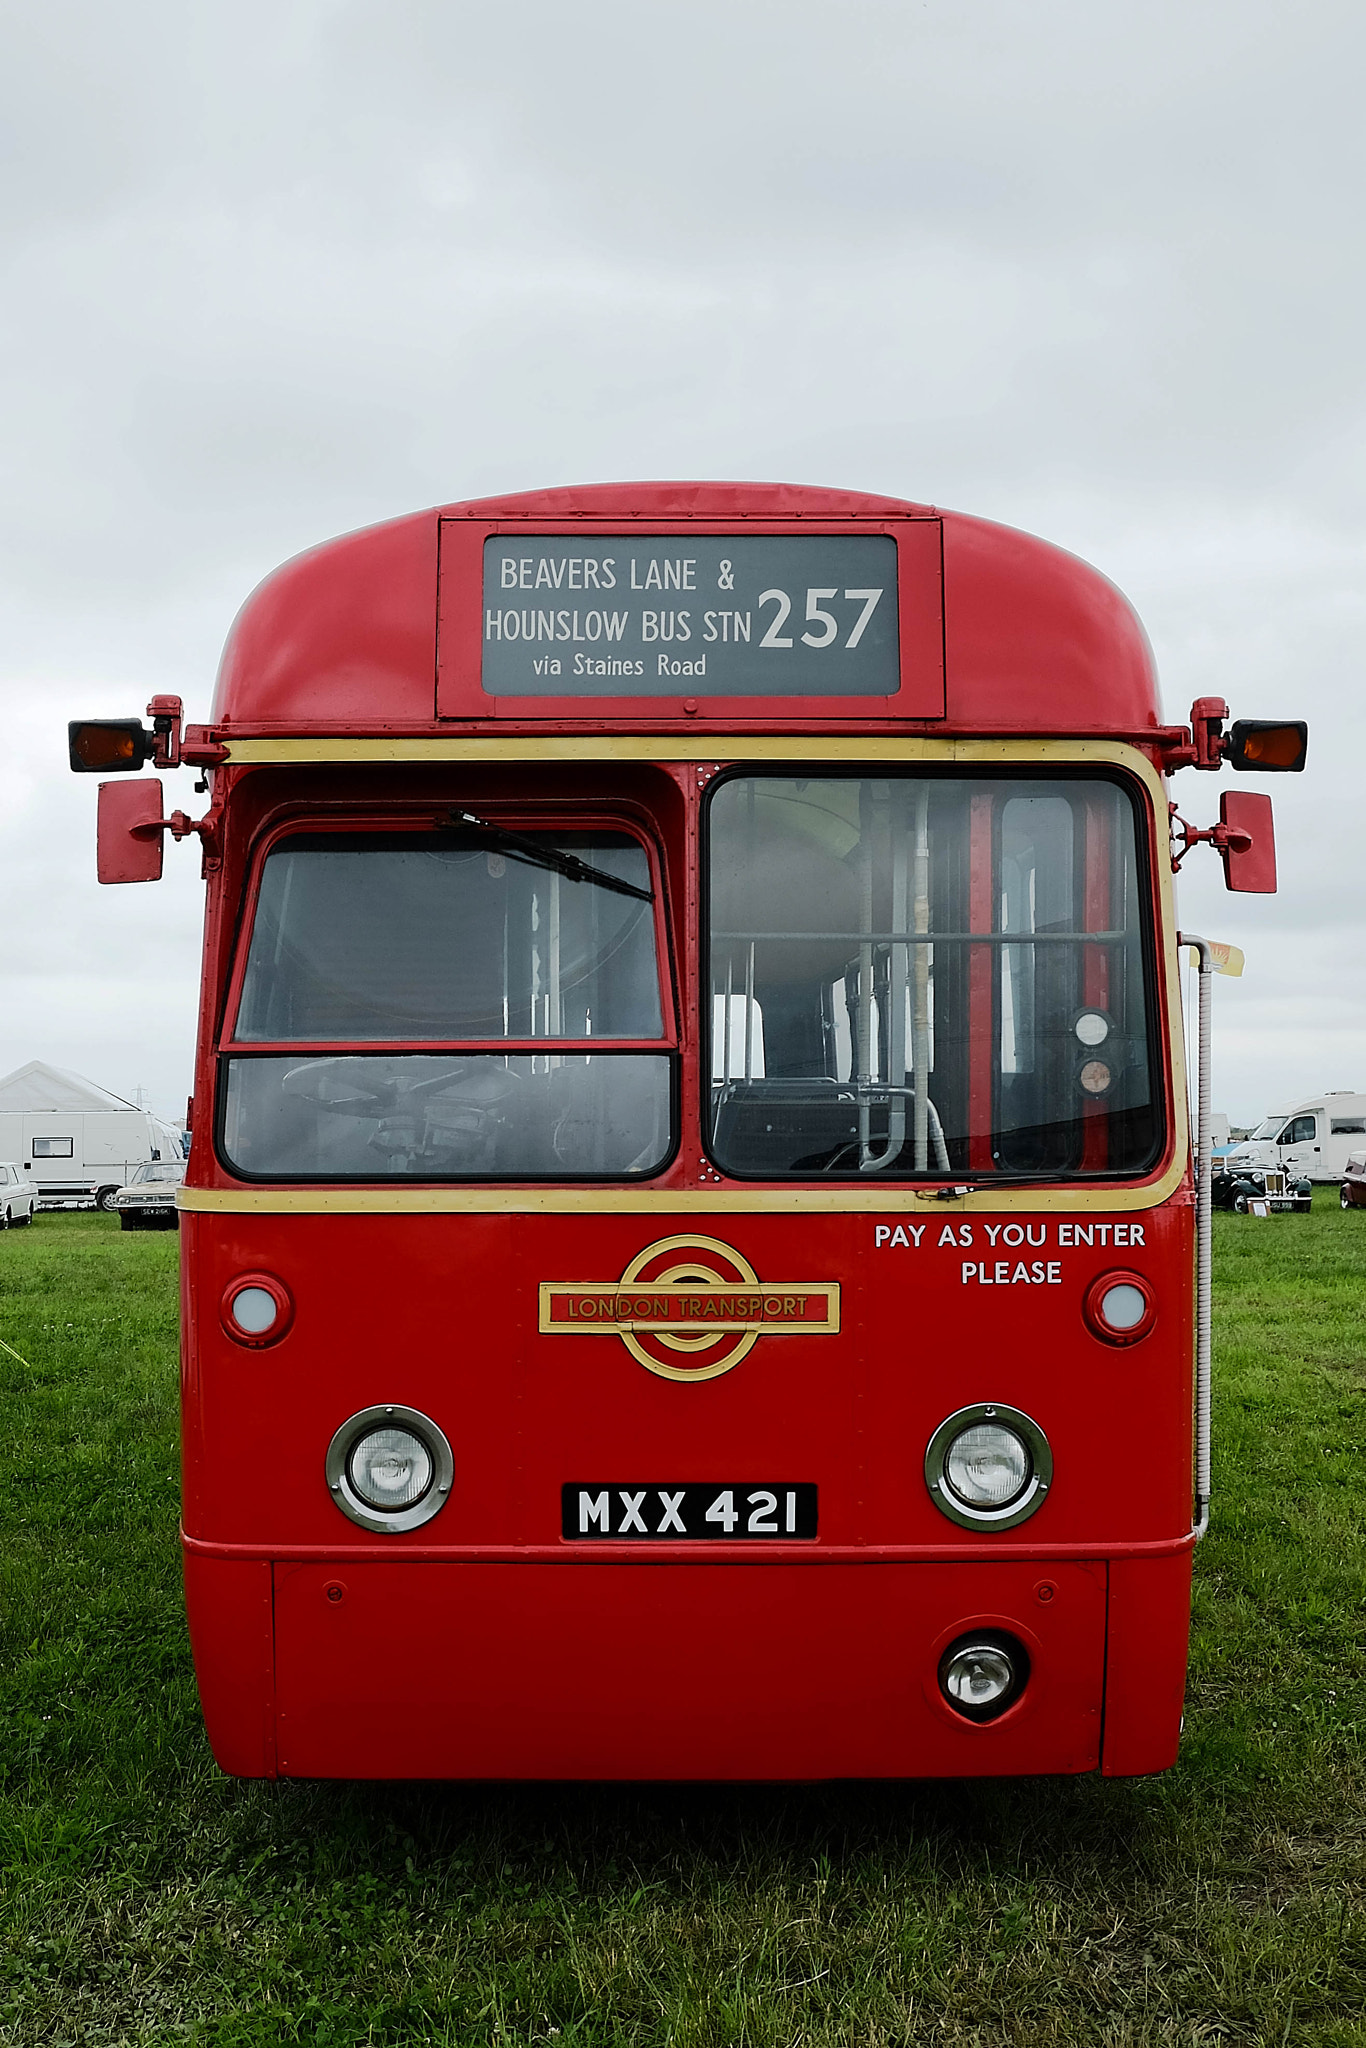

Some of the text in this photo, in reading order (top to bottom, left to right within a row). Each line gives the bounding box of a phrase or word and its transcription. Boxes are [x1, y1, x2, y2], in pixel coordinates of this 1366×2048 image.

[501, 559, 735, 590] BEAVERS LANE &
[485, 610, 752, 642] HOUNSLOW BUS STN
[758, 588, 884, 648] 257
[533, 653, 706, 676] via Staines Road
[875, 1224, 1146, 1247] PAY AS YOU ENTER
[962, 1261, 1062, 1284] PLEASE
[568, 1297, 807, 1318] LONDON TRANSPORT
[579, 1491, 796, 1533] MXX 421
